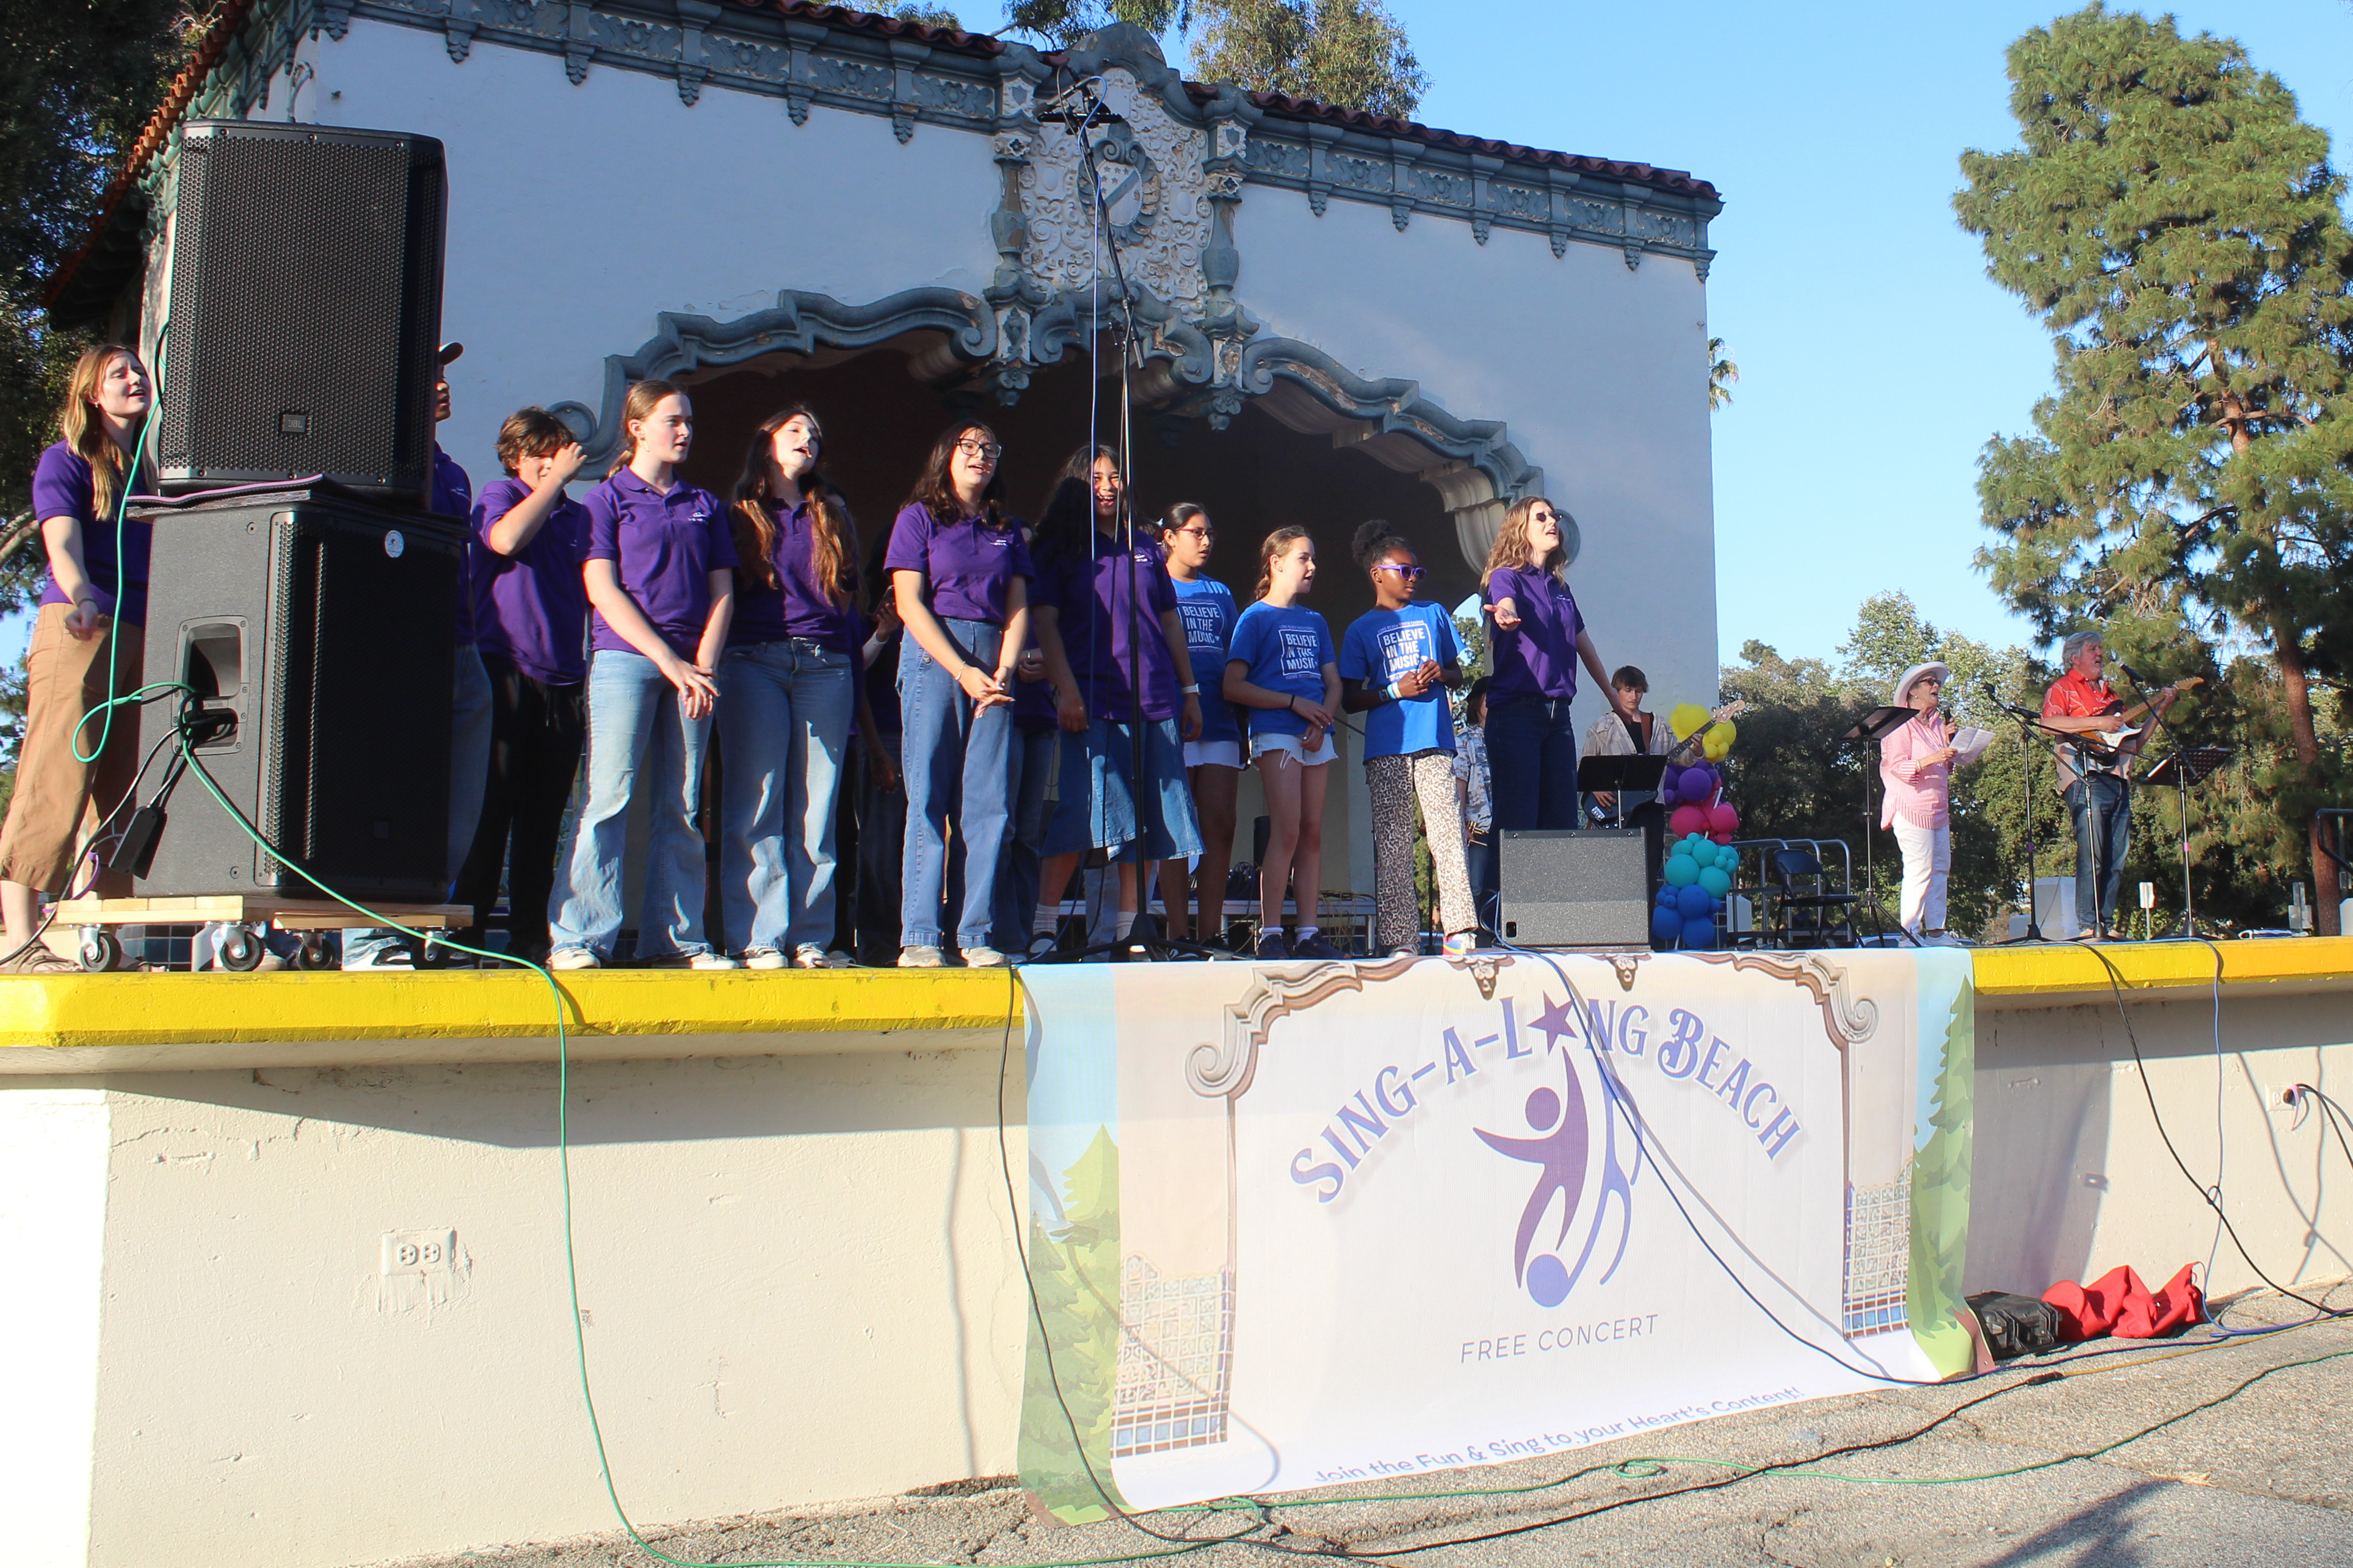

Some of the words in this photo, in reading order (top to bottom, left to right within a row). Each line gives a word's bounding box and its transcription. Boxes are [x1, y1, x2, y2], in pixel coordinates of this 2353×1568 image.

[288, 419, 302, 428] JBL
[1182, 605, 1220, 618] BELIEVE
[1186, 617, 1197, 629] IN
[1197, 618, 1213, 631] THE
[1285, 634, 1318, 647] BELIEVE
[1383, 627, 1426, 646] BELIEVE
[1286, 646, 1295, 659] IN
[1296, 647, 1314, 658] THE
[1386, 645, 1398, 659] IN
[1398, 640, 1419, 655] THE
[1388, 653, 1419, 672] MUSIC
[1657, 1008, 1800, 1162] BEACH
[1461, 1334, 1526, 1364] FREE
[1538, 1313, 1658, 1351] CONCERT
[1314, 1465, 1368, 1483] Join
[1369, 1459, 1415, 1475] the
[1415, 1451, 1465, 1468] Fun
[1467, 1445, 1488, 1461] &
[1488, 1439, 1545, 1457] Sing
[1544, 1433, 1572, 1447] to
[1573, 1422, 1625, 1443] your
[1627, 1406, 1711, 1429] Heart's
[1711, 1386, 1805, 1412] Content!
